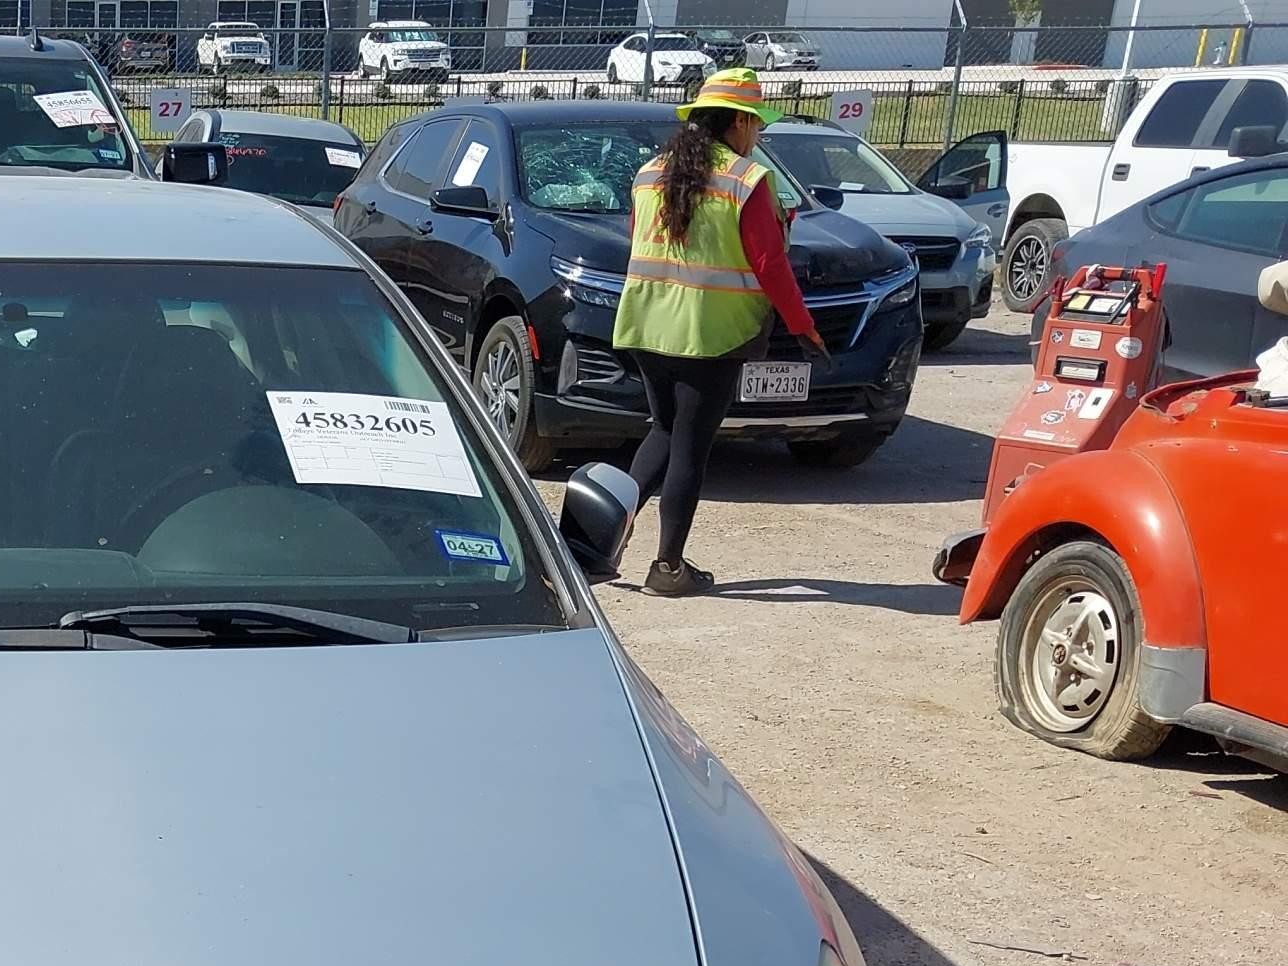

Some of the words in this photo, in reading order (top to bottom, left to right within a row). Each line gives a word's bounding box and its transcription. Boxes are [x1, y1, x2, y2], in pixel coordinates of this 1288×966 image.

[158, 102, 183, 117] 27
[838, 102, 864, 119] 29
[765, 366, 790, 374] TEXAS
[295, 411, 437, 437] 45832605
